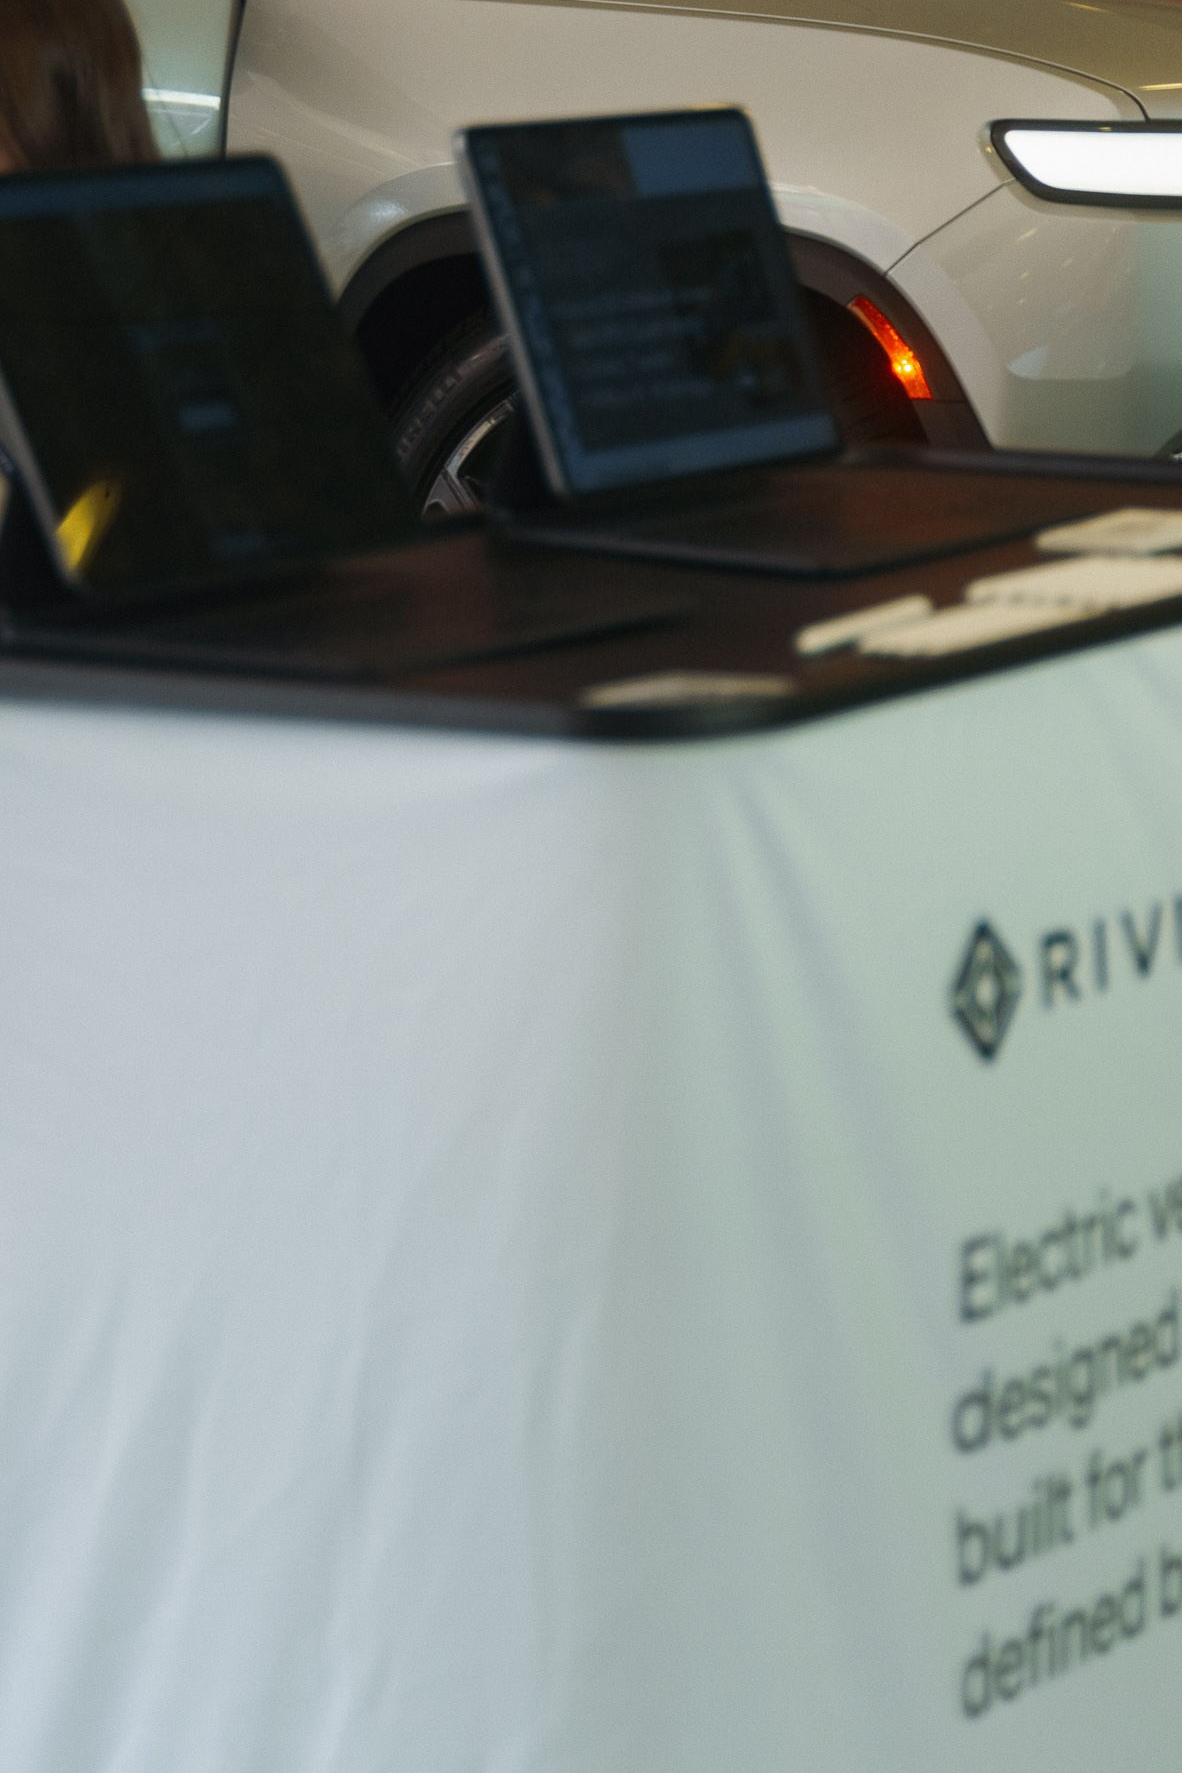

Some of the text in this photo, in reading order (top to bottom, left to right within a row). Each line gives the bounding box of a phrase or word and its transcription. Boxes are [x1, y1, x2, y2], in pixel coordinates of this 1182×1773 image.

[960, 1184, 1138, 1324] Electric
[952, 1284, 1180, 1454] designed
[956, 1472, 1075, 1588] built
[1087, 1447, 1148, 1533] for
[960, 1555, 1146, 1720] defined
